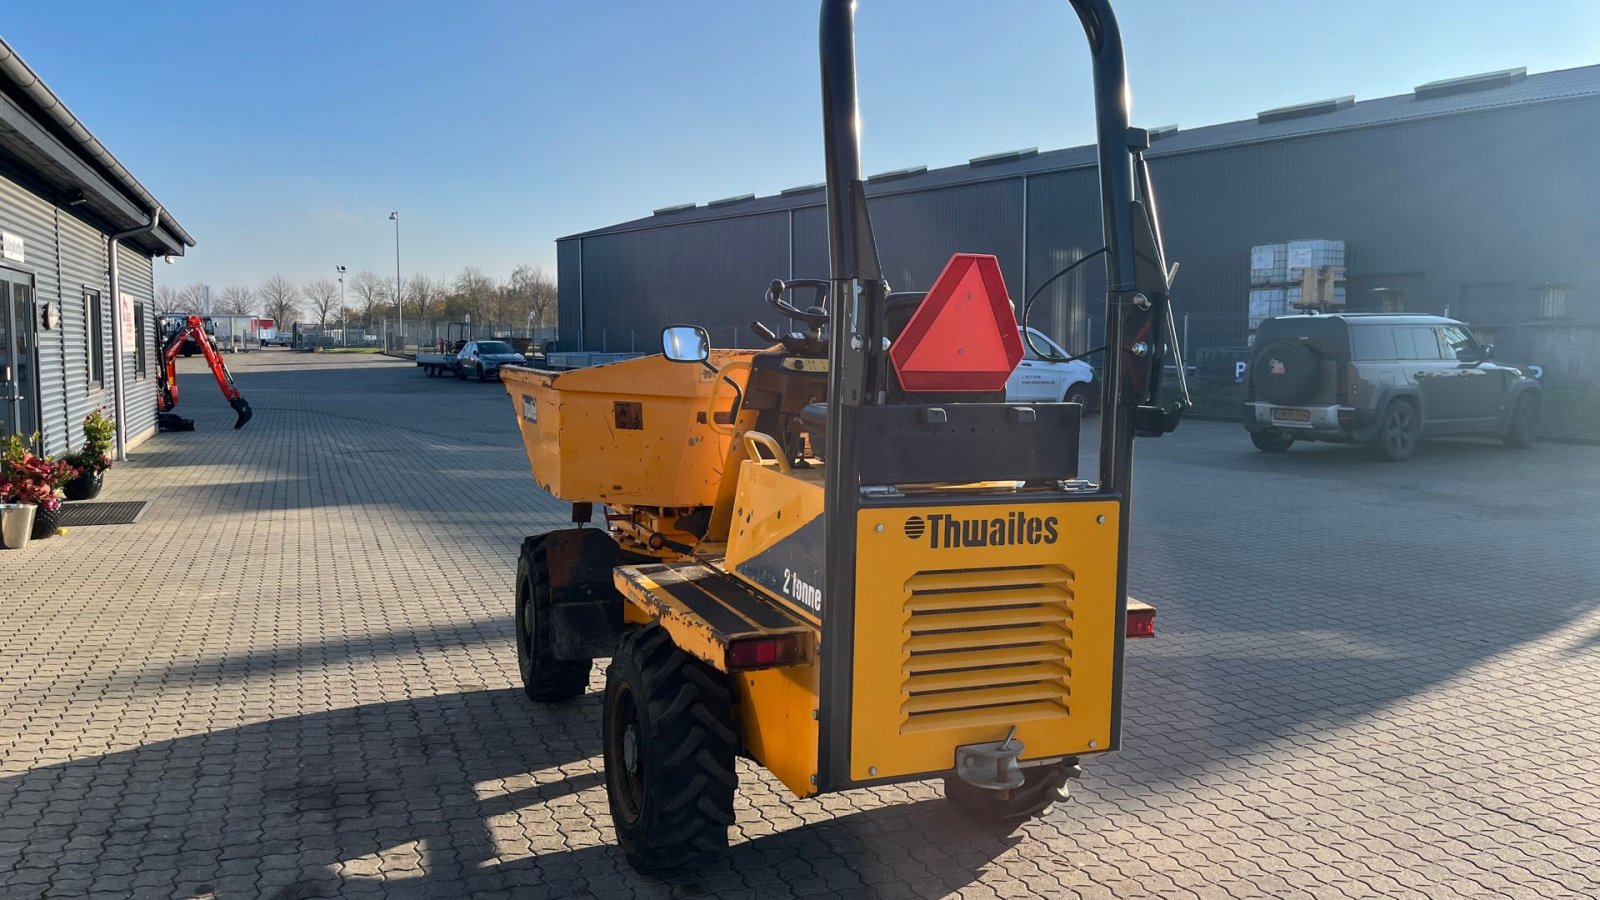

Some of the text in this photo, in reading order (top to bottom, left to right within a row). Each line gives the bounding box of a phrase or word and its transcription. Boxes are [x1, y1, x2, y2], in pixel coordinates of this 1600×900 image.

[927, 511, 1058, 549] Thwaites
[783, 568, 822, 612] 2 tonne
